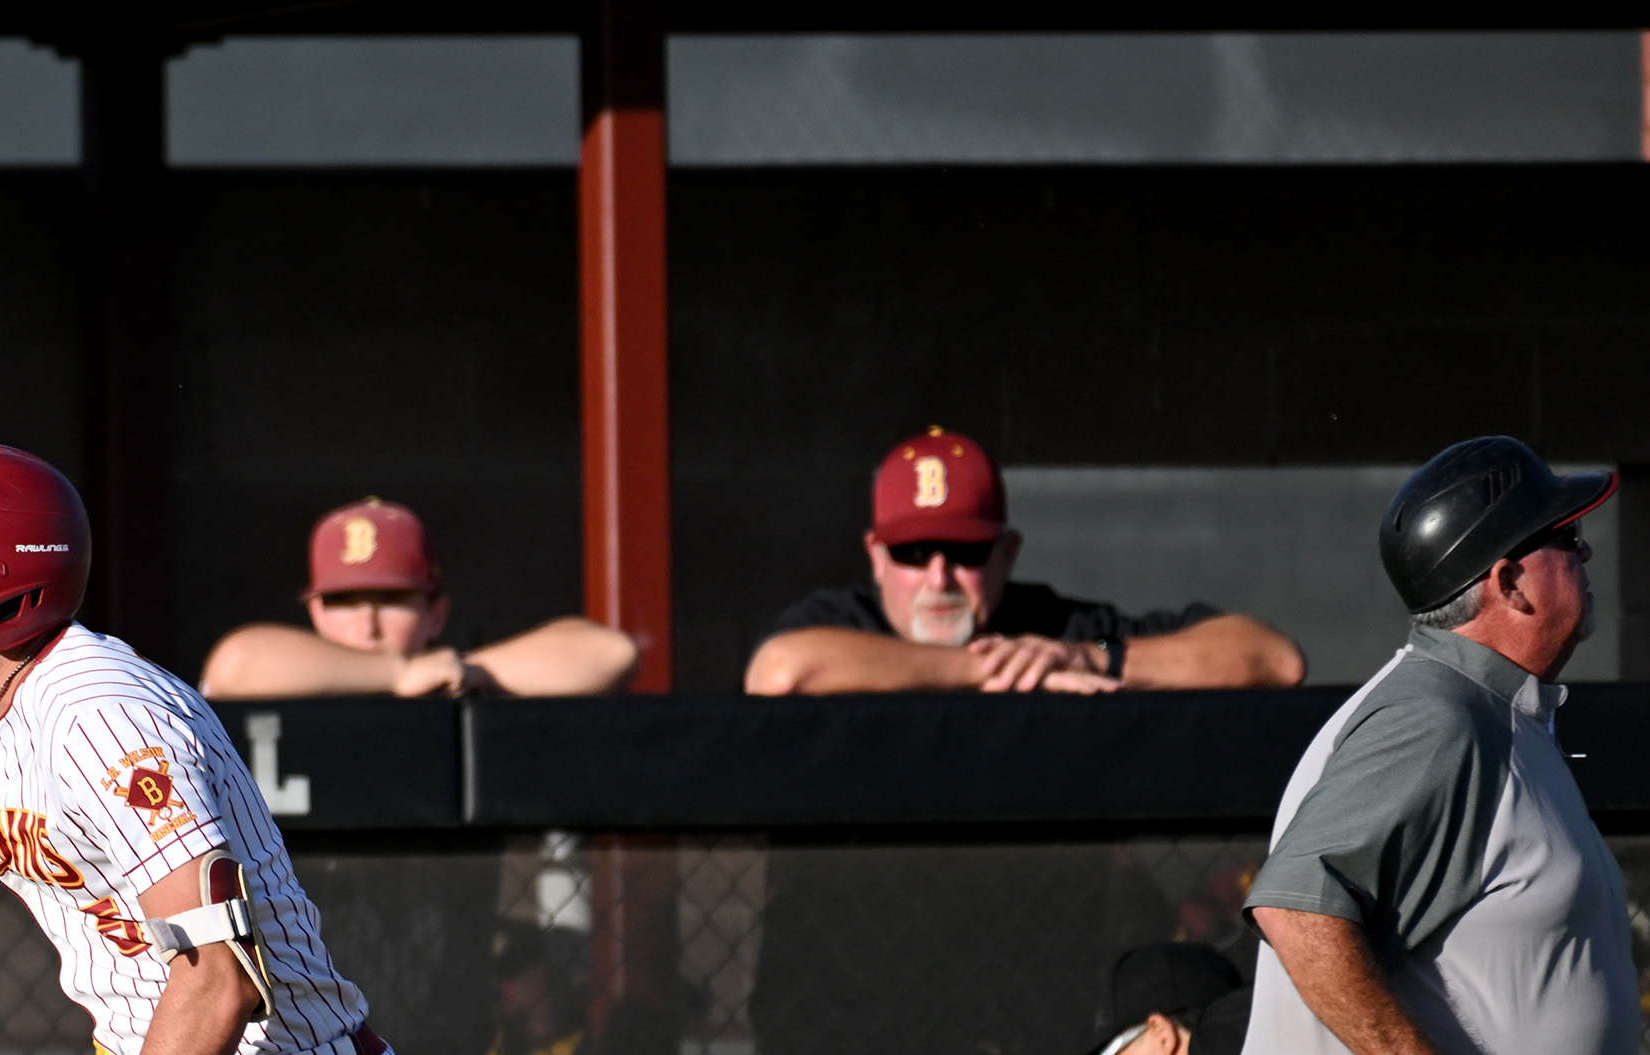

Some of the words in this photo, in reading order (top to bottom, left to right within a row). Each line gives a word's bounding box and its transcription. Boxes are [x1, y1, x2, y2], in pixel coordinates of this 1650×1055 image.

[913, 456, 949, 508] B
[15, 543, 70, 553] RAWLINGS
[118, 746, 166, 769] WILSON
[137, 776, 164, 806] B
[149, 809, 198, 844] BASEBALL
